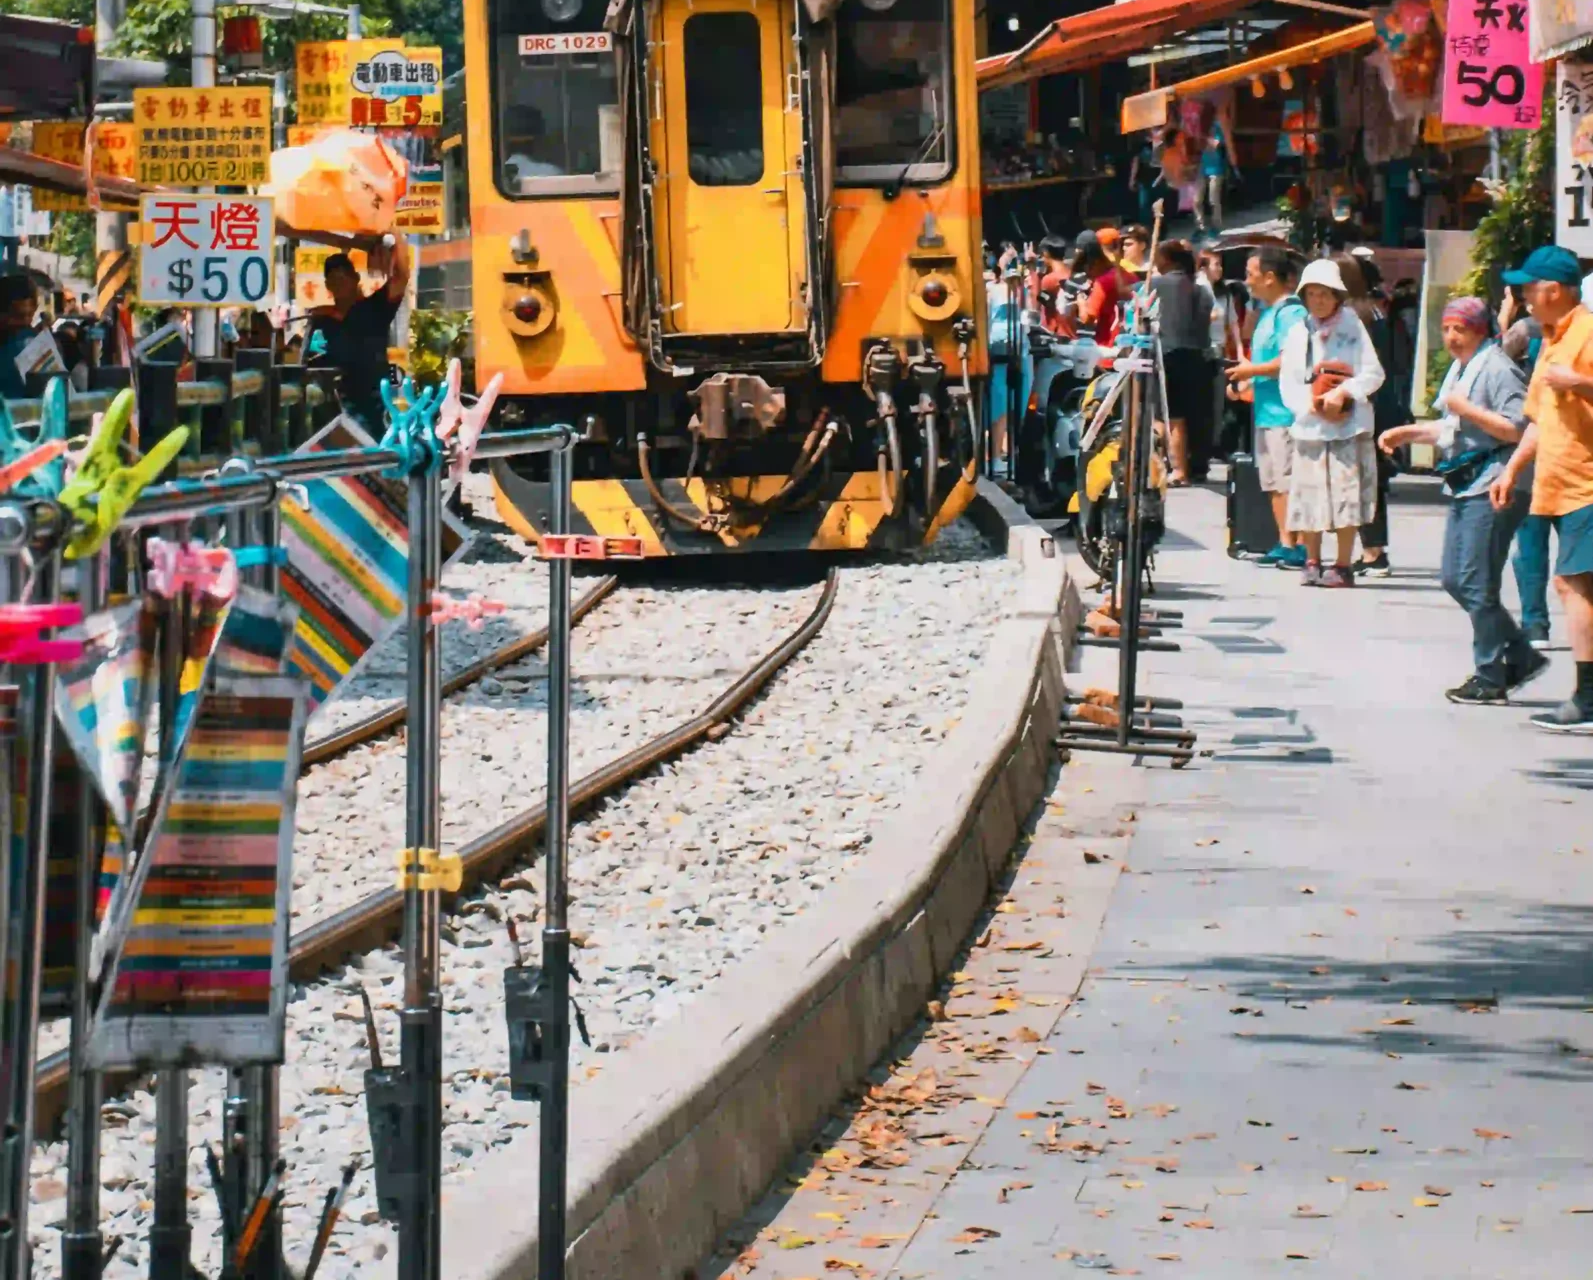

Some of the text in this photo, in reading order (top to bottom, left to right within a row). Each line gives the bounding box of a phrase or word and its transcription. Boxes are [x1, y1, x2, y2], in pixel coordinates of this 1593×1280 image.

[525, 36, 607, 51] DRC 1029
[356, 62, 435, 84] 電動車出租
[1457, 60, 1525, 107] 50
[140, 95, 263, 121] 電動車出租
[151, 202, 260, 250] 天燈
[168, 256, 269, 302] $50
